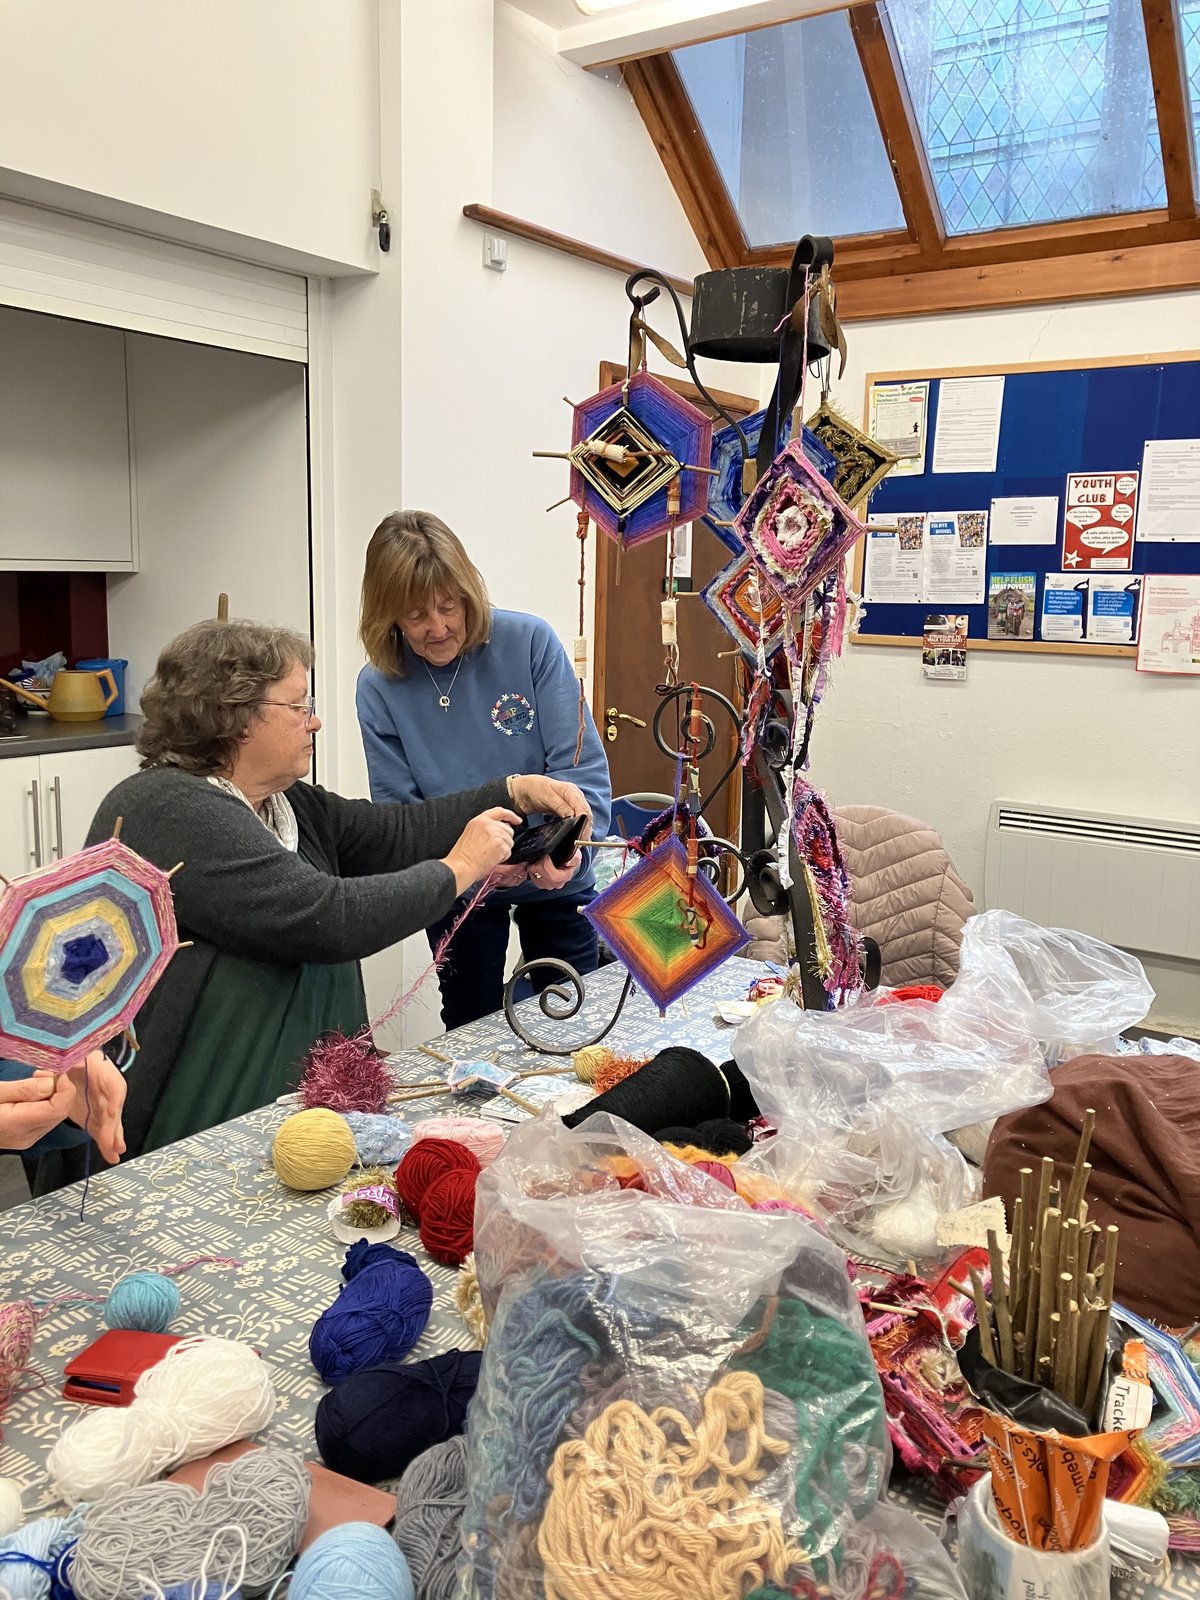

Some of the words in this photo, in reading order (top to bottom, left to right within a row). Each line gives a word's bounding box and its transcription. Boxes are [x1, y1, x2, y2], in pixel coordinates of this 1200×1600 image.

[1074, 479, 1113, 489] YOUTH
[1077, 493, 1107, 503] CLUB
[1010, 576, 1034, 584] FLUSH
